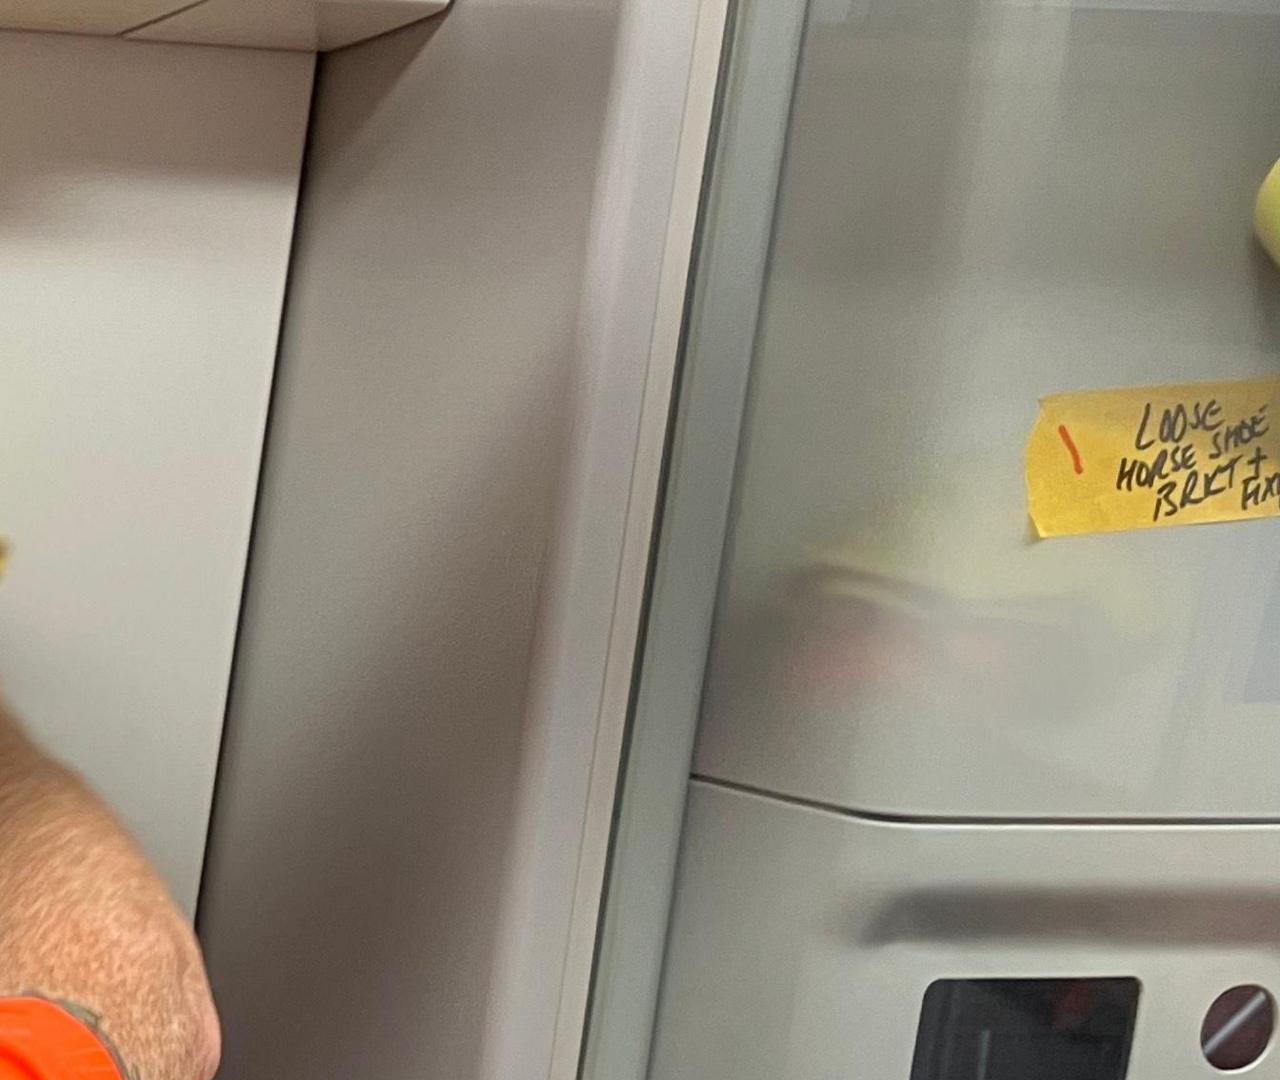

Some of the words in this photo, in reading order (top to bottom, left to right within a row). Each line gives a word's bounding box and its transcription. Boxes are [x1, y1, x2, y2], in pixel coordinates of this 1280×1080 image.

[1116, 444, 1198, 492] HORSE
[1208, 403, 1270, 460] SHOE
[1135, 400, 1225, 451] LOOSE
[1152, 454, 1244, 522] BRKT
